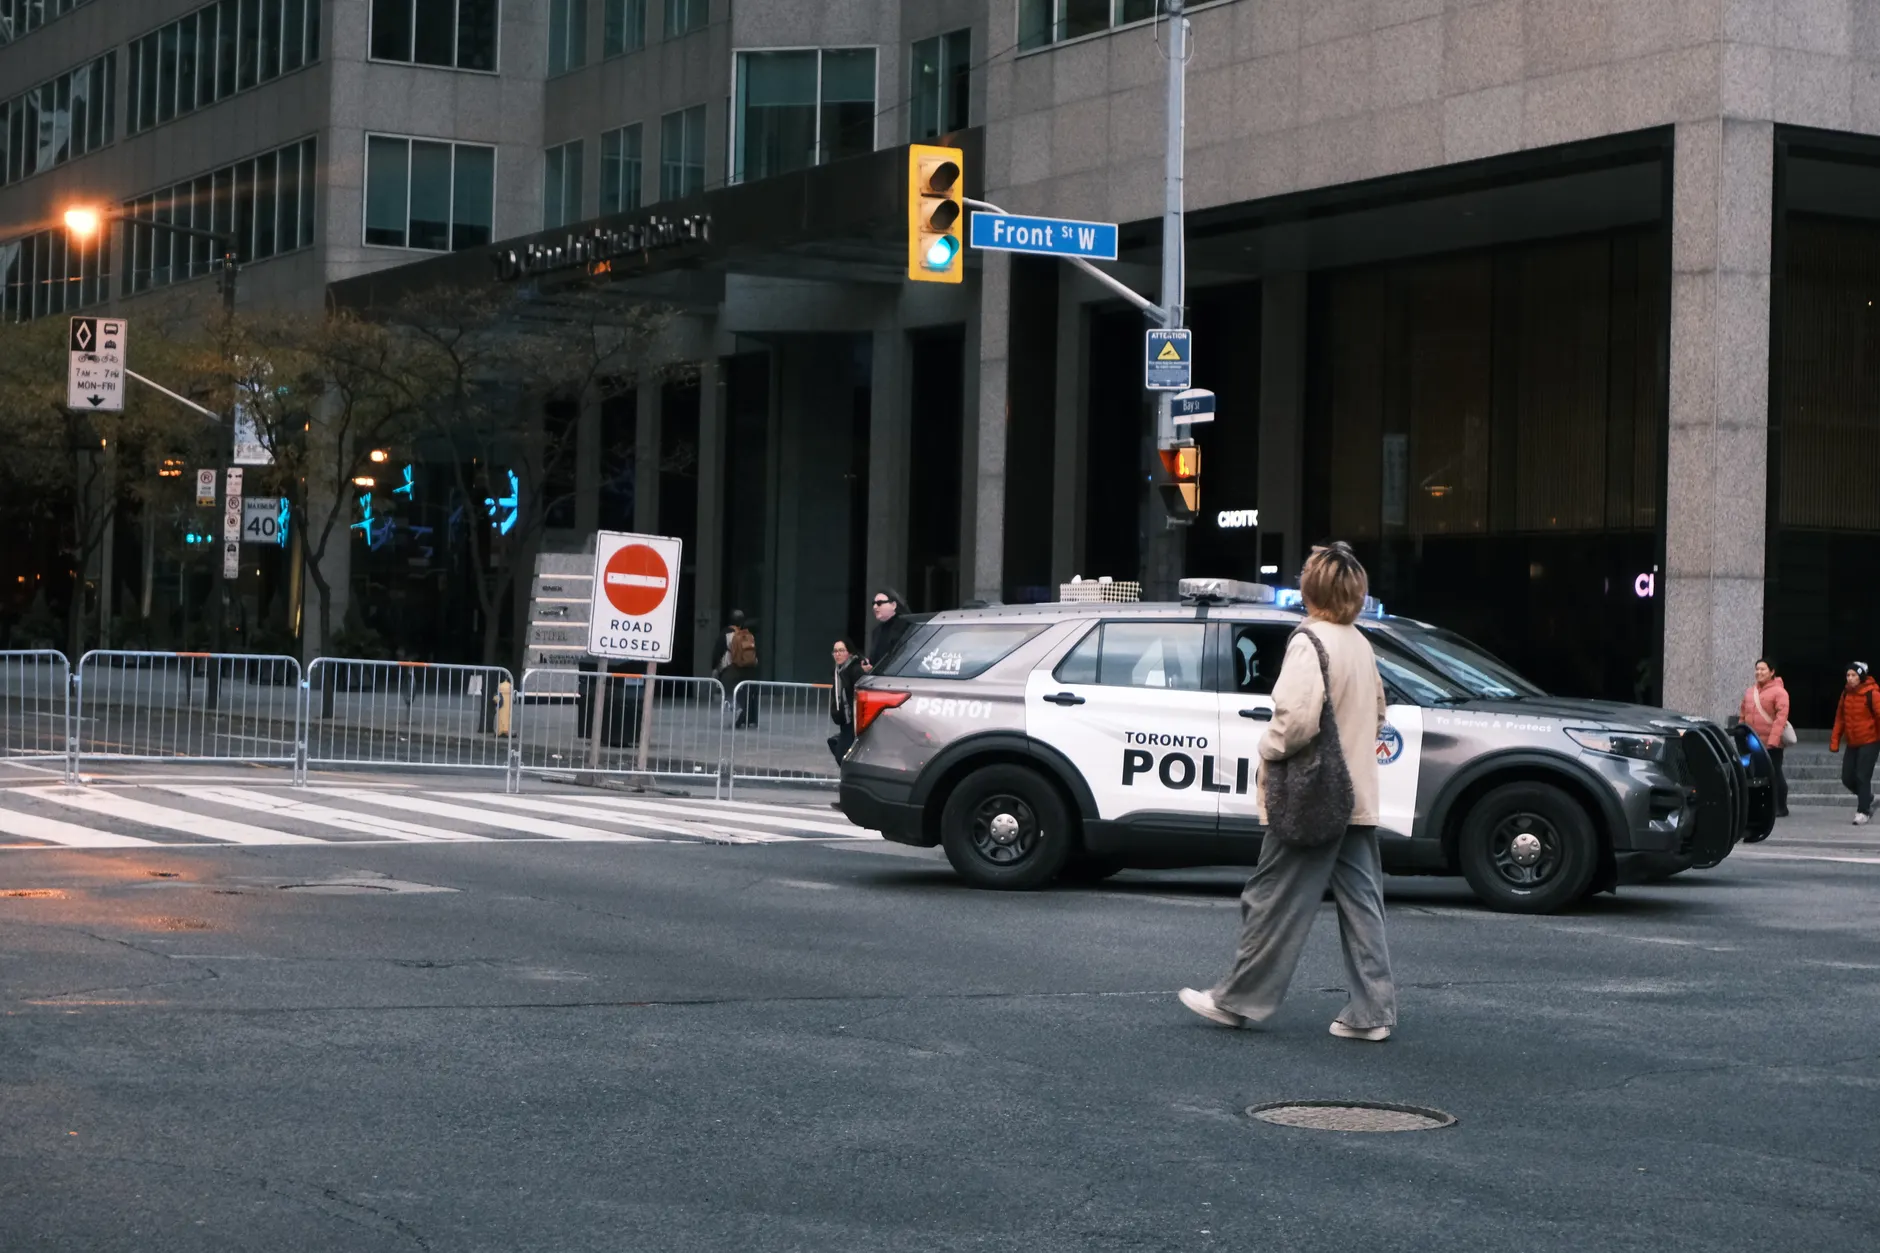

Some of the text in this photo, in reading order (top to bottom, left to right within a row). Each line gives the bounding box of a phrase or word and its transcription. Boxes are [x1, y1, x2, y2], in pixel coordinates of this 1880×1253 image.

[994, 219, 1095, 250] Front St W
[1151, 332, 1187, 340] ATTENTION
[77, 381, 116, 391] MON-FRI
[1182, 400, 1194, 413] Bay
[247, 502, 276, 510] MAXIMUM
[247, 516, 276, 537] 40
[611, 619, 653, 633] ROAD
[600, 636, 660, 651] CLOSED
[941, 651, 962, 659] CALL
[915, 697, 993, 719] PSRT01
[1435, 716, 1552, 732] To Serve & Protect
[1125, 731, 1208, 749] TORONTO
[1122, 748, 1258, 795] POLI
